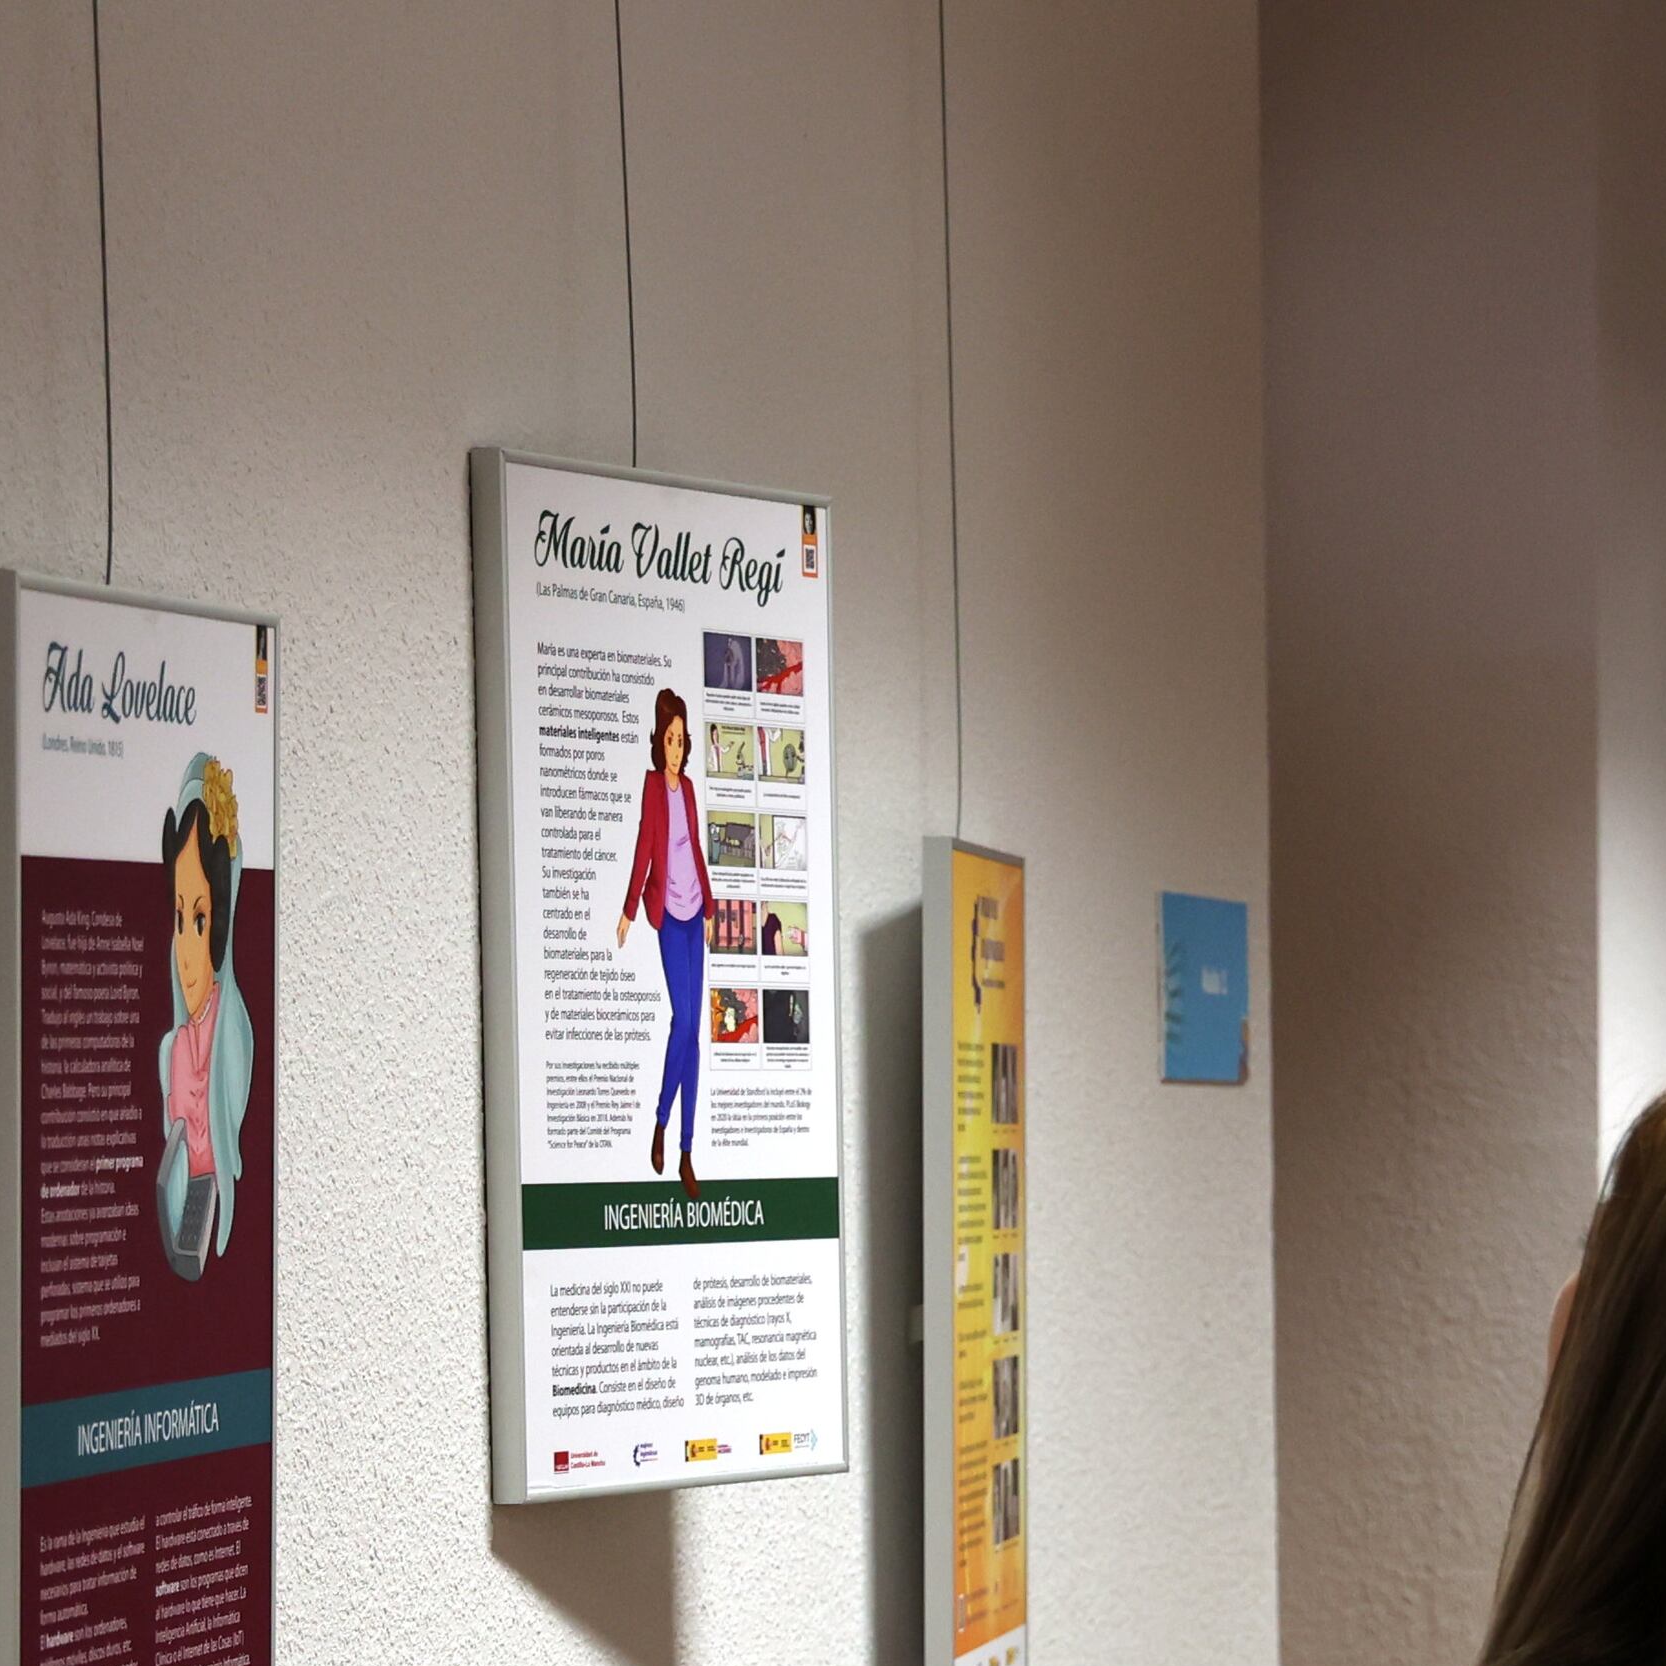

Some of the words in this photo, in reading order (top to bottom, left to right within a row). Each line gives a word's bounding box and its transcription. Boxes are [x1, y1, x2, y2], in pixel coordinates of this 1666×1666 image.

[534, 509, 624, 574] María
[631, 522, 713, 584] Vallet
[719, 537, 786, 607] Regí
[536, 582, 551, 598] (Las
[551, 584, 577, 599] Palmas
[578, 587, 588, 600] de
[589, 588, 607, 602] Gran
[43, 642, 95, 713] Ada
[101, 651, 197, 726] Lovelace
[603, 1198, 682, 1229] INGENIERÍA
[686, 1195, 764, 1227] BIOMÉDICA
[78, 1408, 141, 1455] INGENIERÍA
[144, 1395, 219, 1443] INFORMÁTICA
